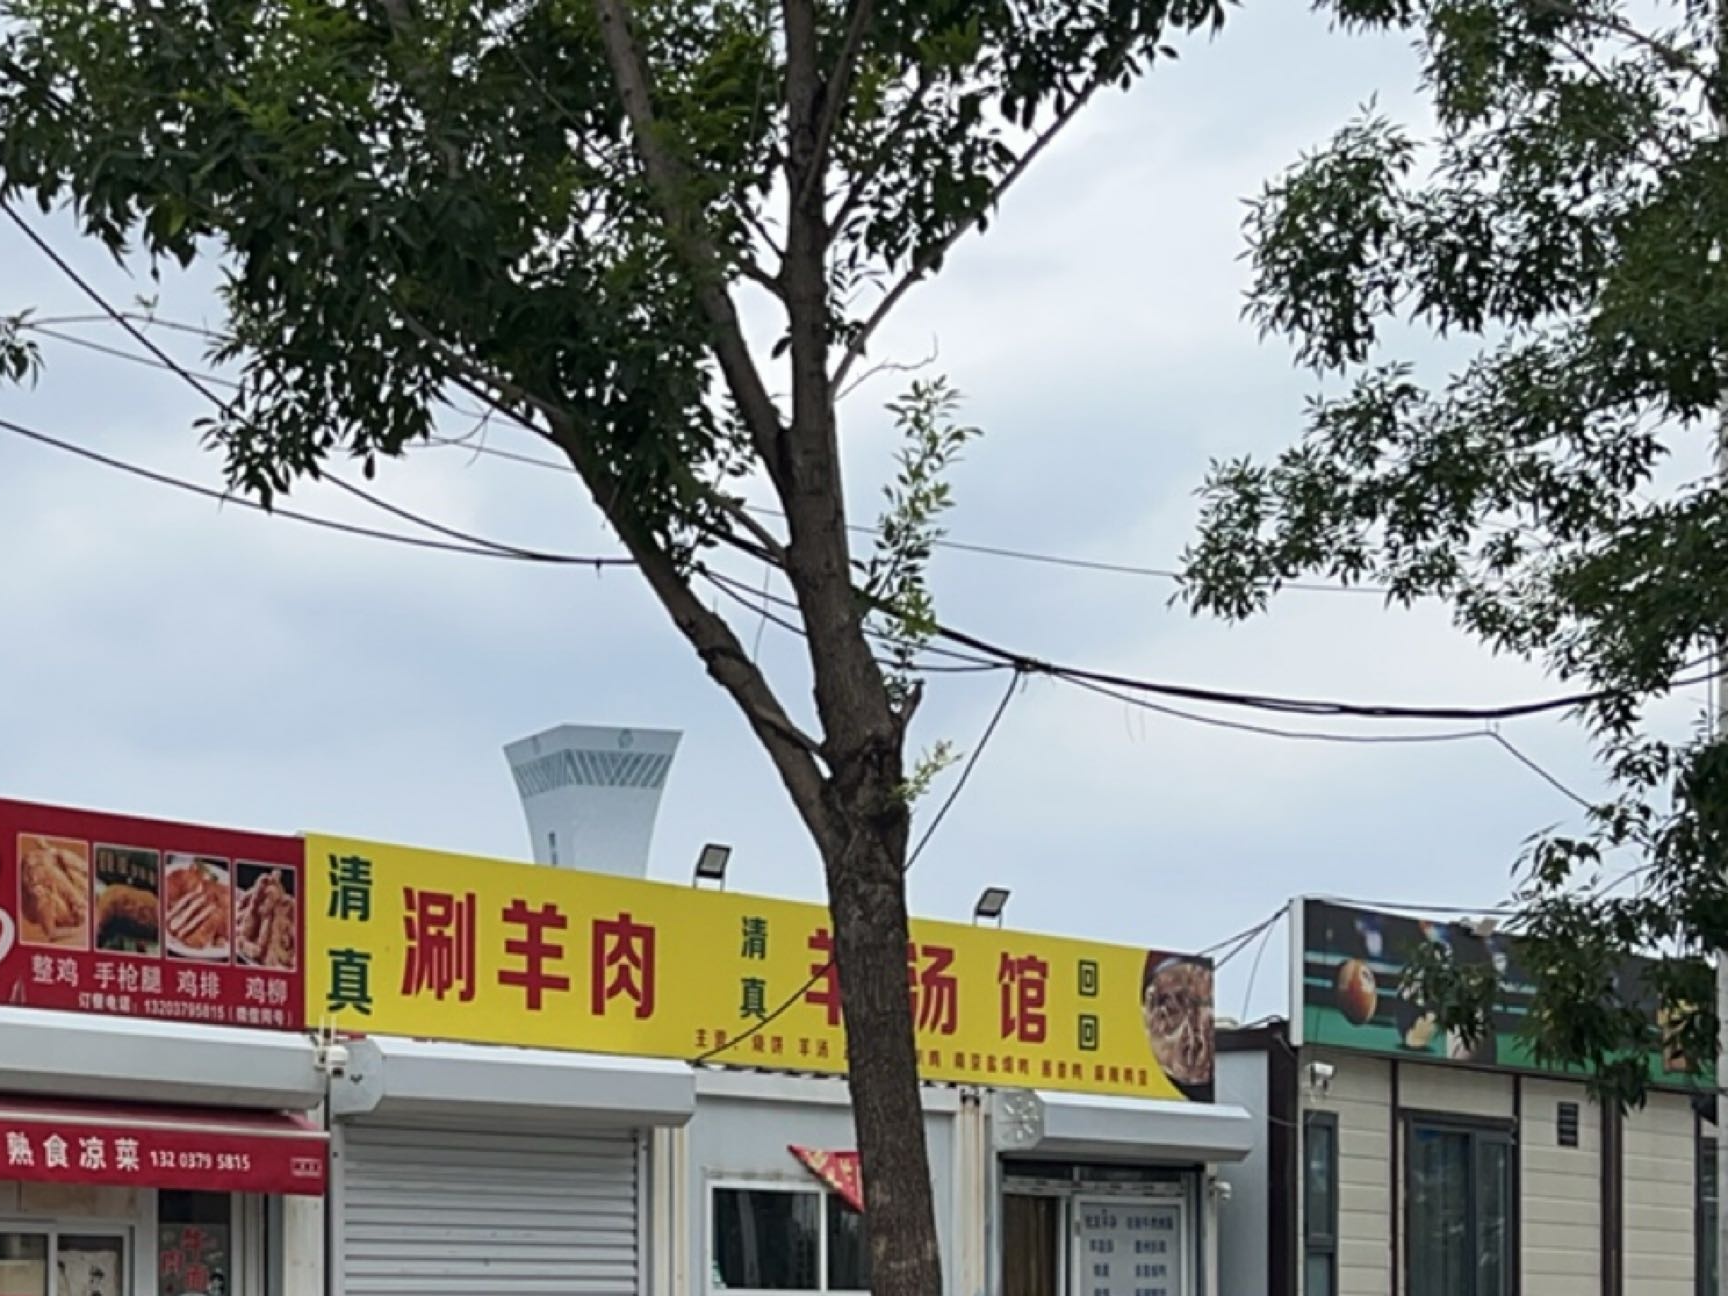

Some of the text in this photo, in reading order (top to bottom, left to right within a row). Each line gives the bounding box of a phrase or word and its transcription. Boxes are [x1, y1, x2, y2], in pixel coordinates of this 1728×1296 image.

[177, 969, 220, 999] 鸡排
[327, 854, 372, 1015] 清真
[402, 887, 656, 1020] 涮羊肉
[741, 916, 768, 1021] 清真
[7, 1131, 250, 1172] 熟食凉菜 132 0379 5815
